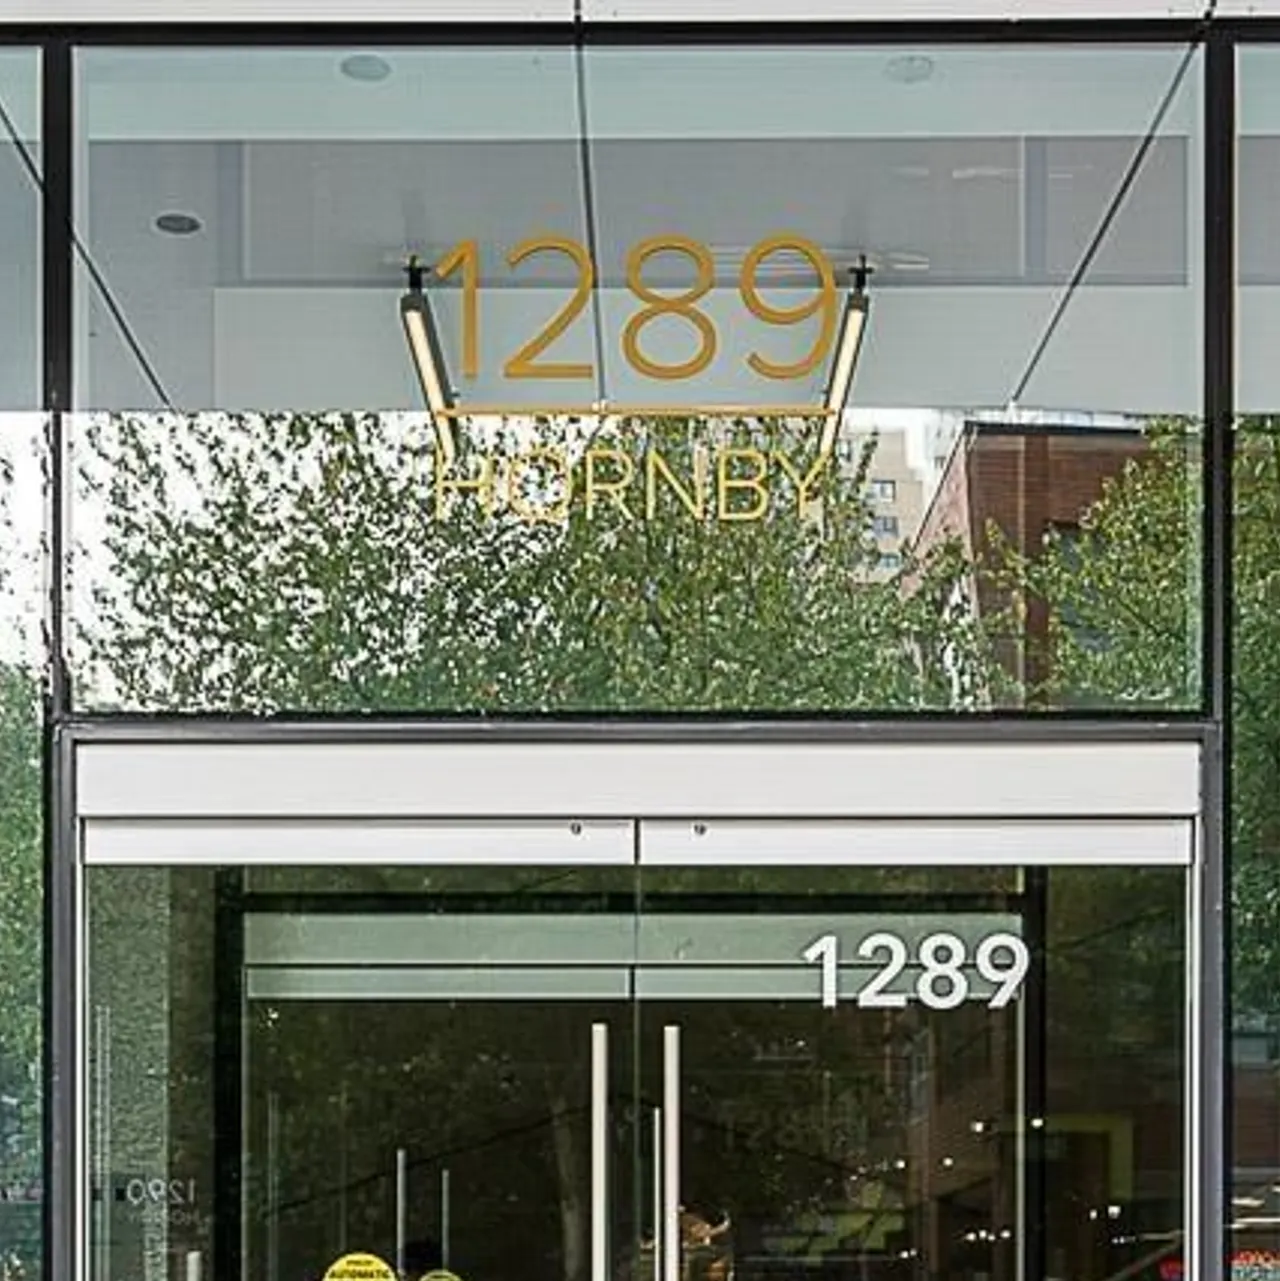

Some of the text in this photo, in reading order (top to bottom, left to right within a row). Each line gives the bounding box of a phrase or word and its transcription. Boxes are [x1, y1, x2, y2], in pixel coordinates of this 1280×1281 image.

[435, 234, 838, 380] 1289
[435, 448, 829, 523] HORNBY
[802, 932, 1030, 1010] 1289
[328, 1269, 391, 1279] AUTOMATIC
